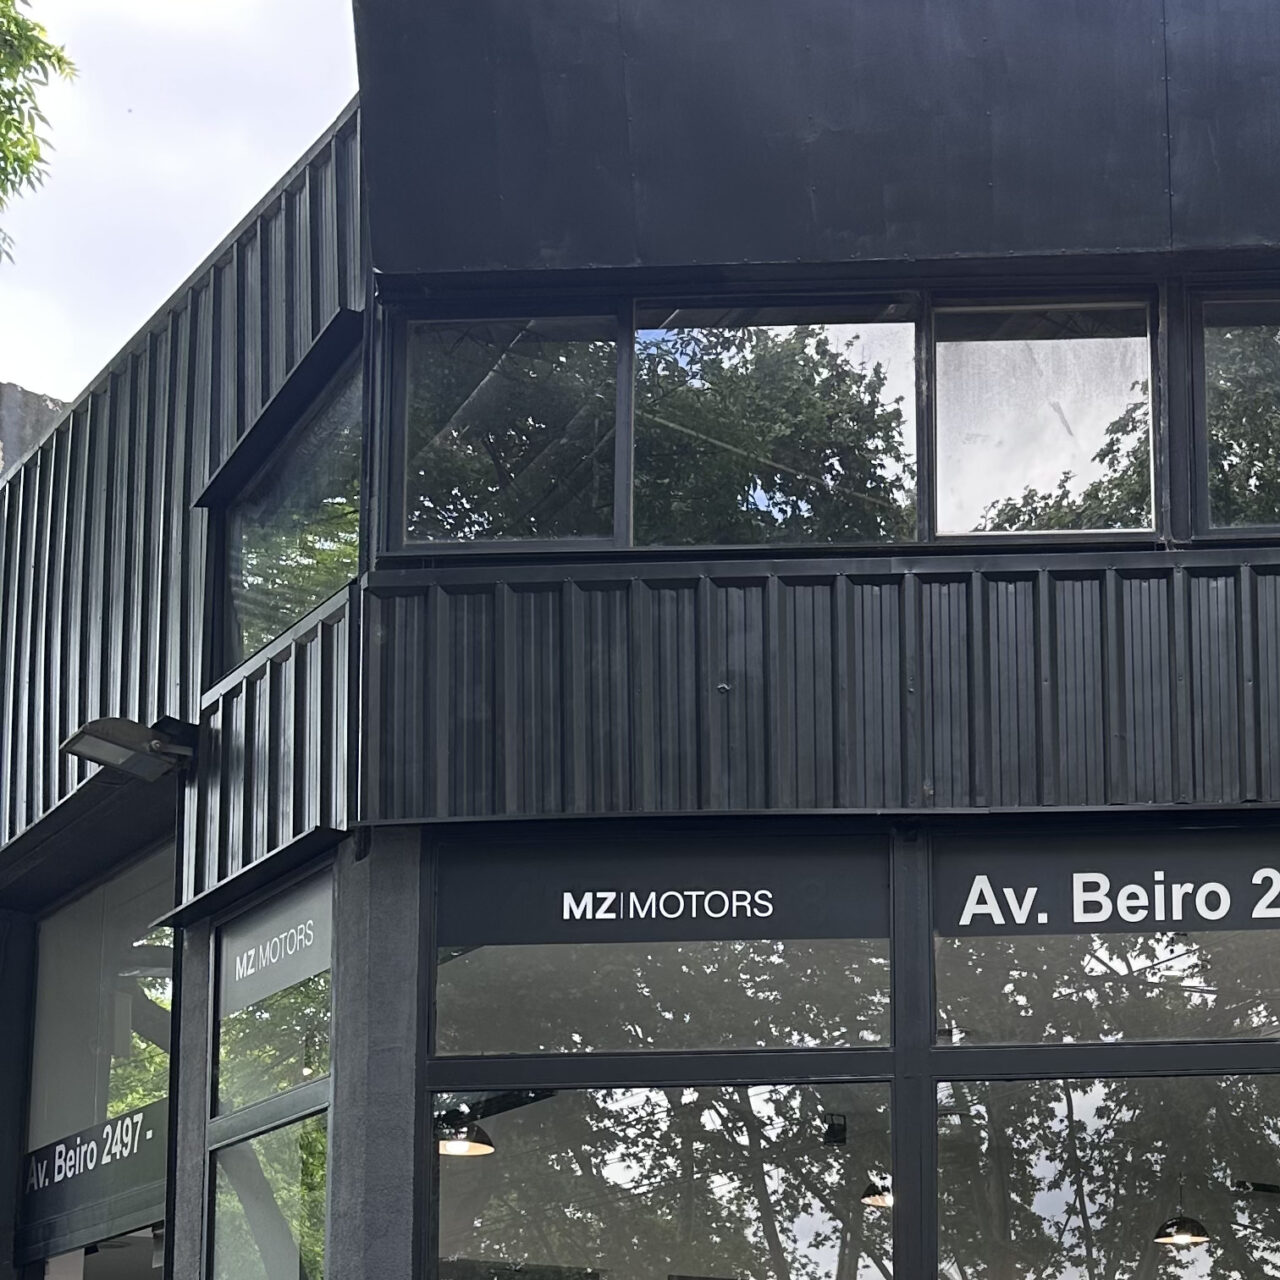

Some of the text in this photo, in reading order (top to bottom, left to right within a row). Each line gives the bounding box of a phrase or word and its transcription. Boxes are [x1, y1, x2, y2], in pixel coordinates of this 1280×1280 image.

[629, 889, 774, 919] MOTORS
[958, 875, 1048, 926] Av.
[1072, 871, 1231, 923] Beiro
[259, 919, 314, 970] MOTORS
[26, 1156, 49, 1194] Av.
[54, 1137, 98, 1183] Beiro
[101, 1112, 144, 1165] 2497
